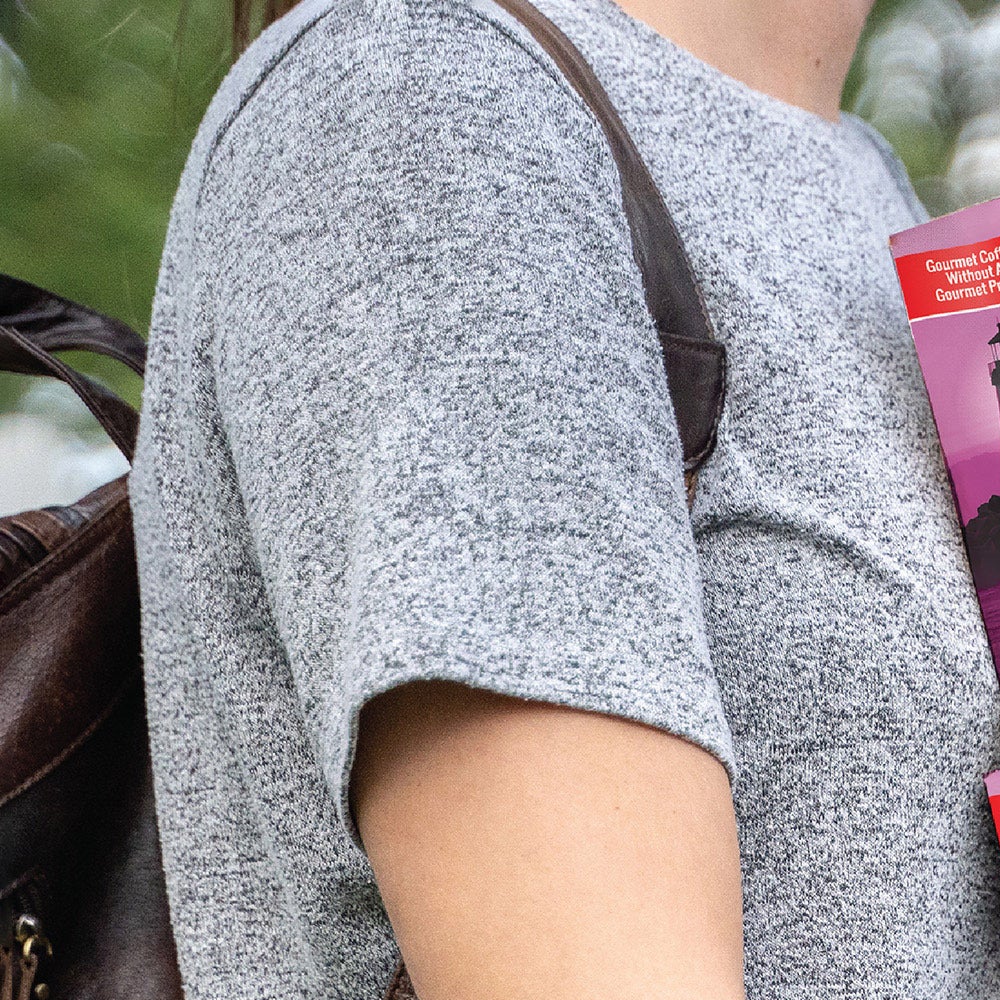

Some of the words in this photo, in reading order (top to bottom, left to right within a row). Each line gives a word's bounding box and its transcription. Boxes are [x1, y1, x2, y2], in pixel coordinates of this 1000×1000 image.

[925, 253, 978, 273] Gourmet
[945, 265, 994, 285] Without
[935, 282, 988, 302] Gourmet
